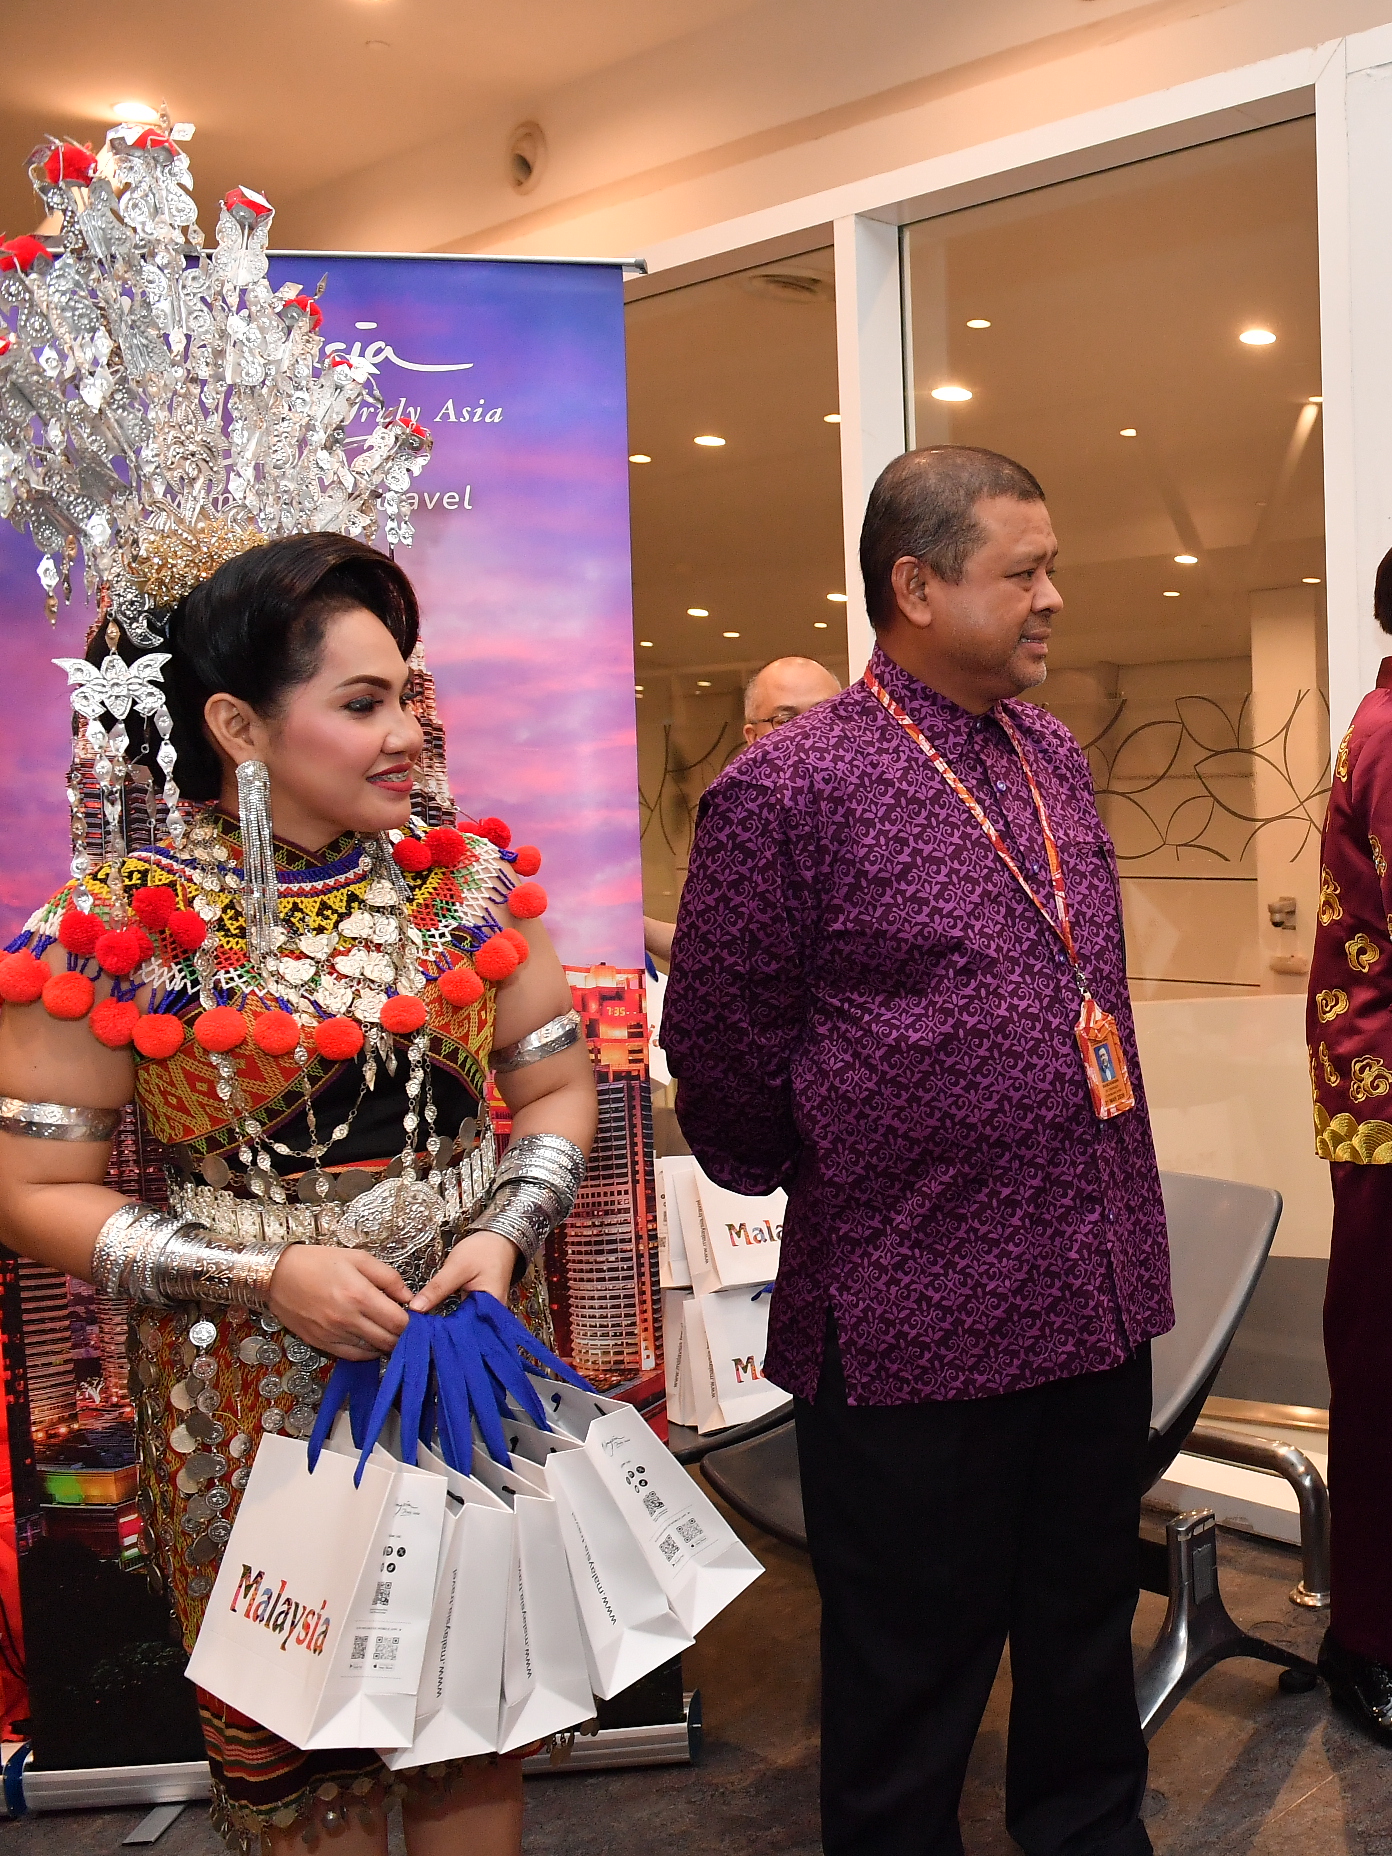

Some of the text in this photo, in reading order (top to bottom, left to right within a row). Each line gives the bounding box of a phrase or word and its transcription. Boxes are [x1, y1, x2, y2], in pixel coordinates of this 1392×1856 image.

[433, 398, 504, 424] Asia
[724, 1218, 784, 1247] Mala
[228, 1563, 332, 1658] Malaysia
